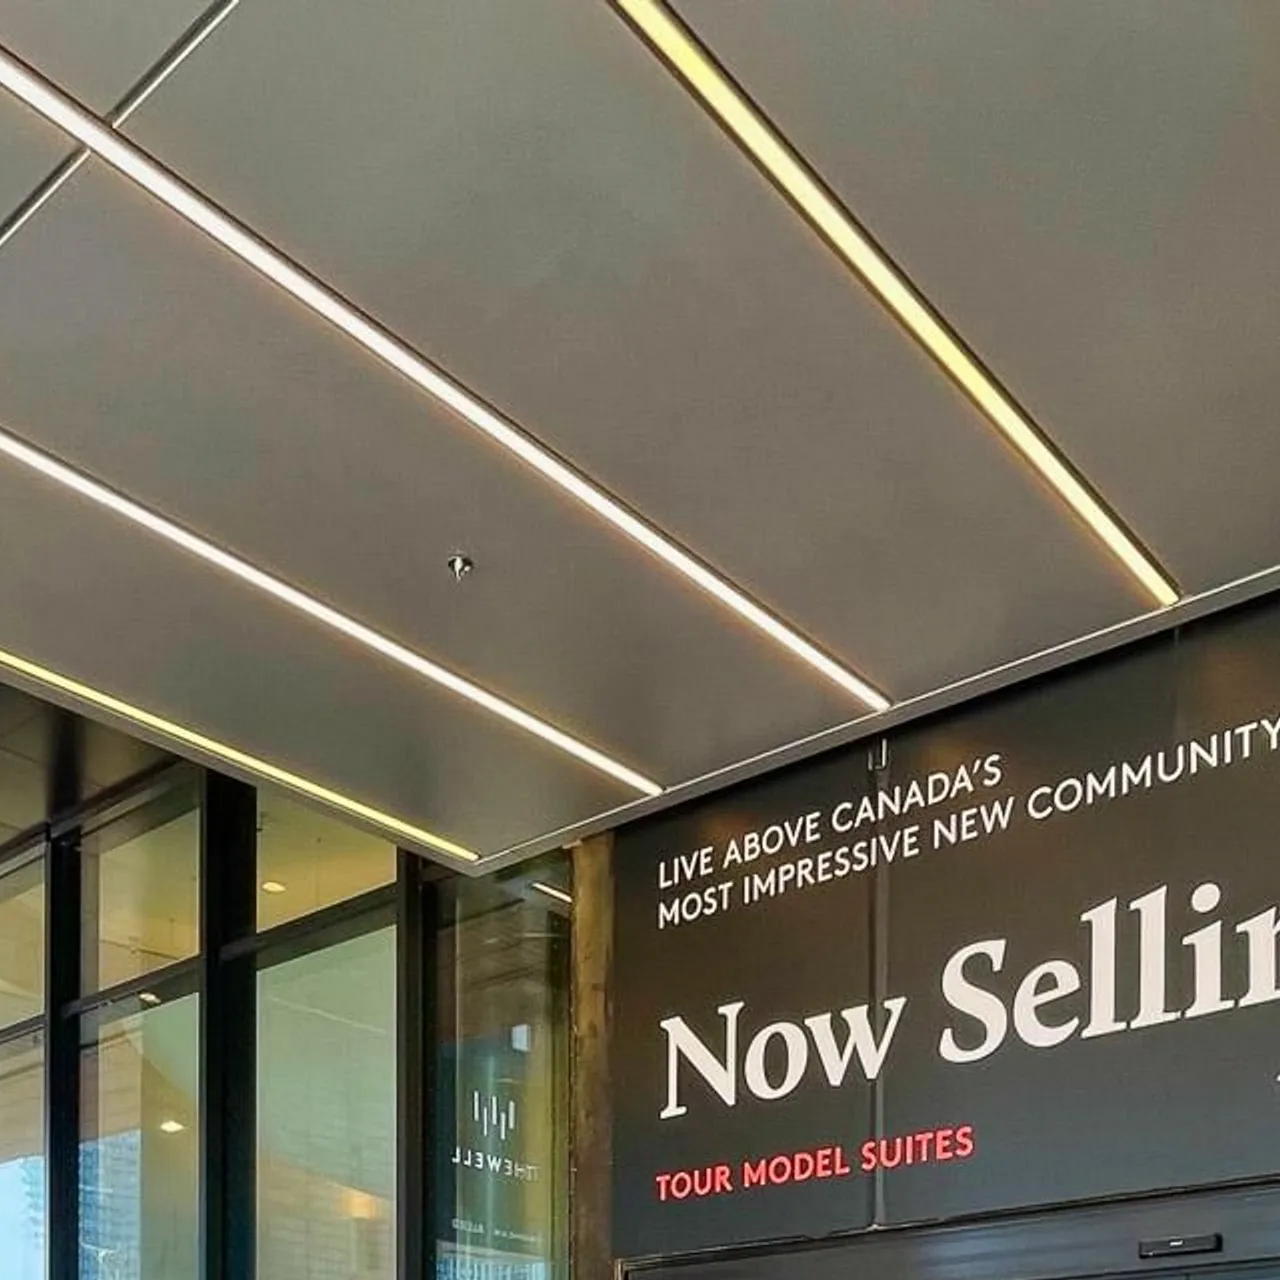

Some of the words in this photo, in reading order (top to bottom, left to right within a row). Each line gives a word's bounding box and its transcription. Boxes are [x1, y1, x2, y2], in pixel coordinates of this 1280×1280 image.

[658, 846, 714, 890] LIVE
[723, 811, 821, 869] ABOVE
[831, 753, 1003, 834] CANADA'S
[658, 881, 734, 930] MOST
[743, 825, 920, 905] IMPRESSIVE
[933, 796, 1014, 850] NEW
[658, 994, 908, 1121] Now
[655, 1165, 733, 1201] TOUR
[743, 1146, 851, 1188] MODEL
[860, 1125, 975, 1172] SUITES
